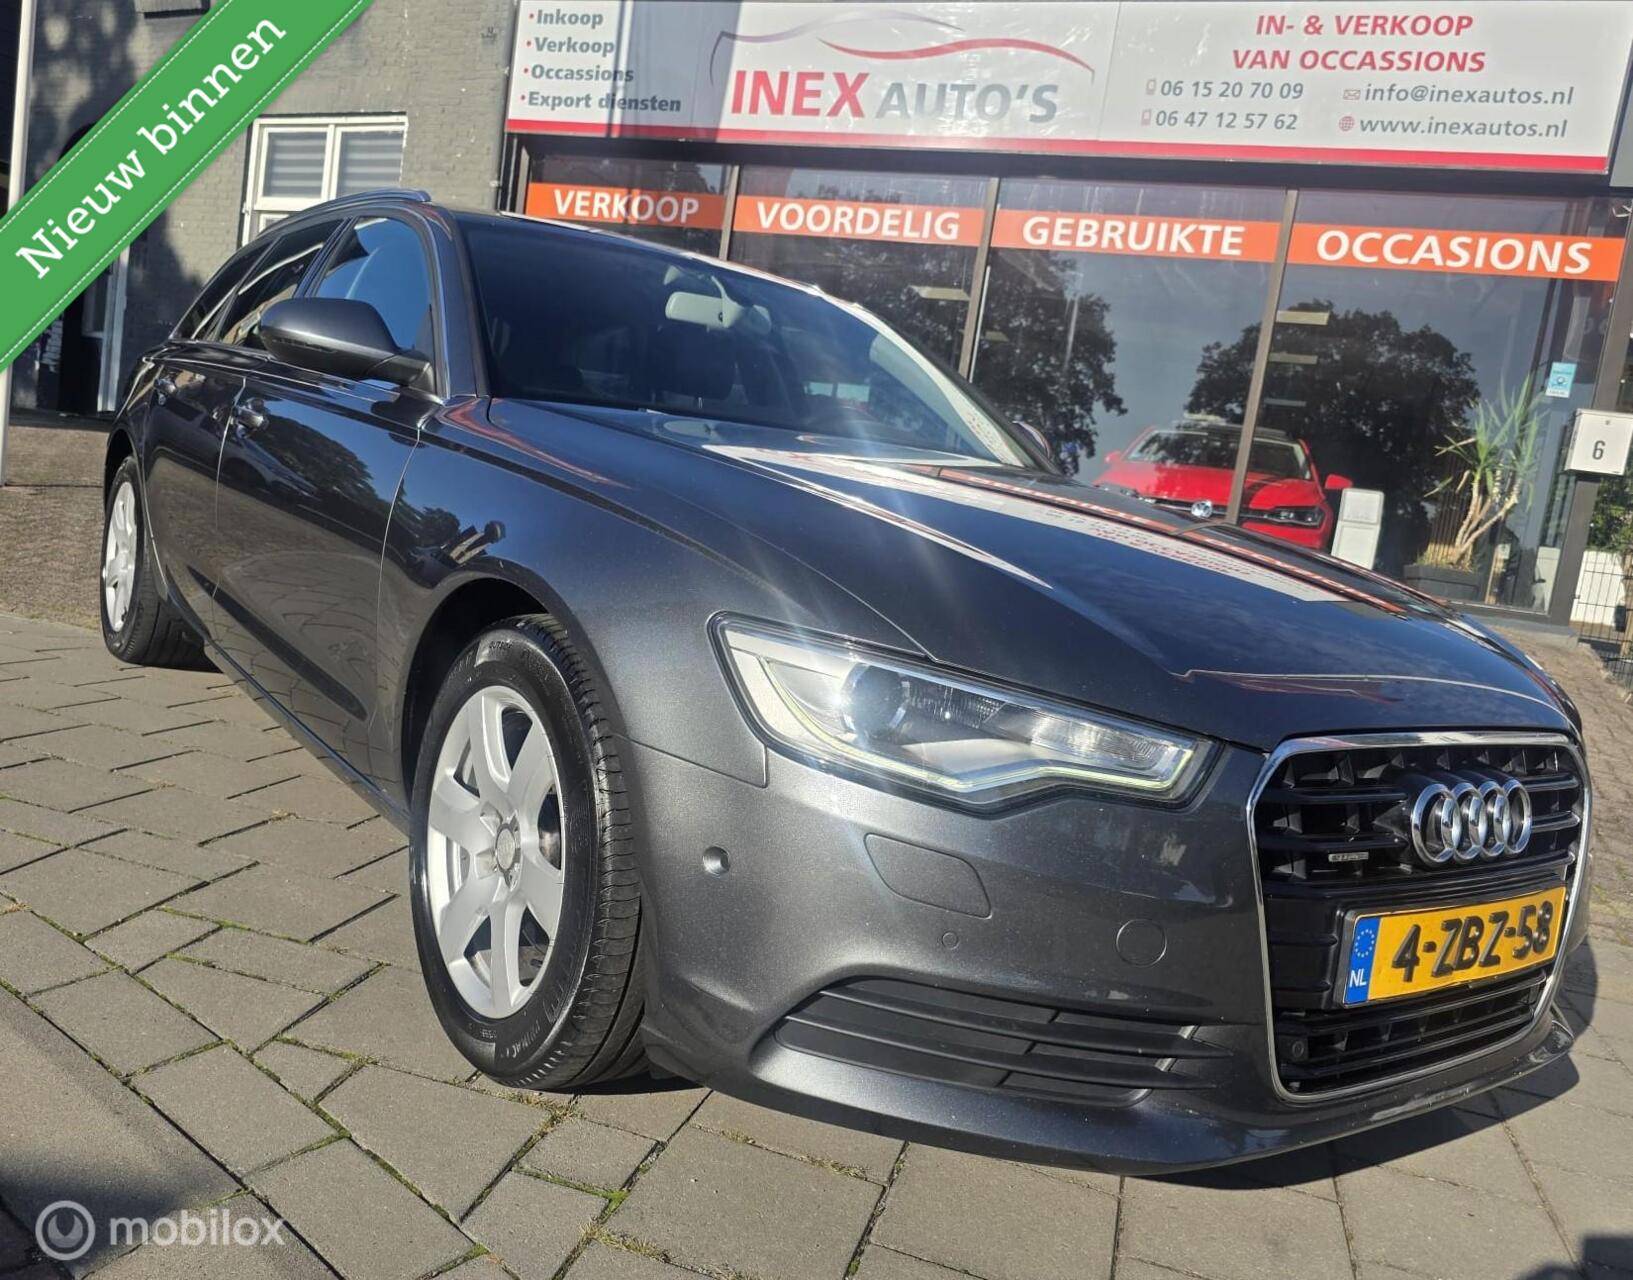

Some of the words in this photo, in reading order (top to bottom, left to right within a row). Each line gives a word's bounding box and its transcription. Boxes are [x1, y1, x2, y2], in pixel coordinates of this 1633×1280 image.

[536, 9, 603, 29] Inkoop
[1256, 15, 1294, 35] IN-
[1303, 15, 1324, 36] &
[1334, 15, 1473, 36] VERKOOP
[534, 37, 615, 57] Verkoop
[1232, 49, 1290, 69] VAN
[1299, 49, 1486, 72] OCCASSIONS
[531, 64, 634, 82] Occassions
[731, 70, 869, 118] INEX
[875, 82, 1058, 123] AUTO'S
[1160, 80, 1184, 97] 06
[1192, 81, 1213, 98] 15
[1218, 82, 1243, 98] 20
[1250, 82, 1273, 99] 70
[1279, 83, 1304, 99] 09
[1364, 83, 1575, 105] info@inexautos.nl
[527, 91, 592, 110] Export
[598, 92, 681, 112] diensten
[1155, 110, 1178, 127] 06
[1184, 111, 1208, 127] 47
[1216, 112, 1237, 128] 12
[1244, 113, 1268, 129] 57
[1274, 114, 1298, 130] 62
[1359, 116, 1568, 138] www.inexautos.nl
[553, 189, 699, 224] VERKOOP
[757, 201, 960, 241] VOORDELIG
[1021, 216, 1245, 256] GEBRUIKTE
[1315, 230, 1592, 275] OCCASIONS
[1592, 440, 1606, 460] 6
[1391, 901, 1553, 983] 4-ZBZ-58
[1349, 968, 1367, 988] NL
